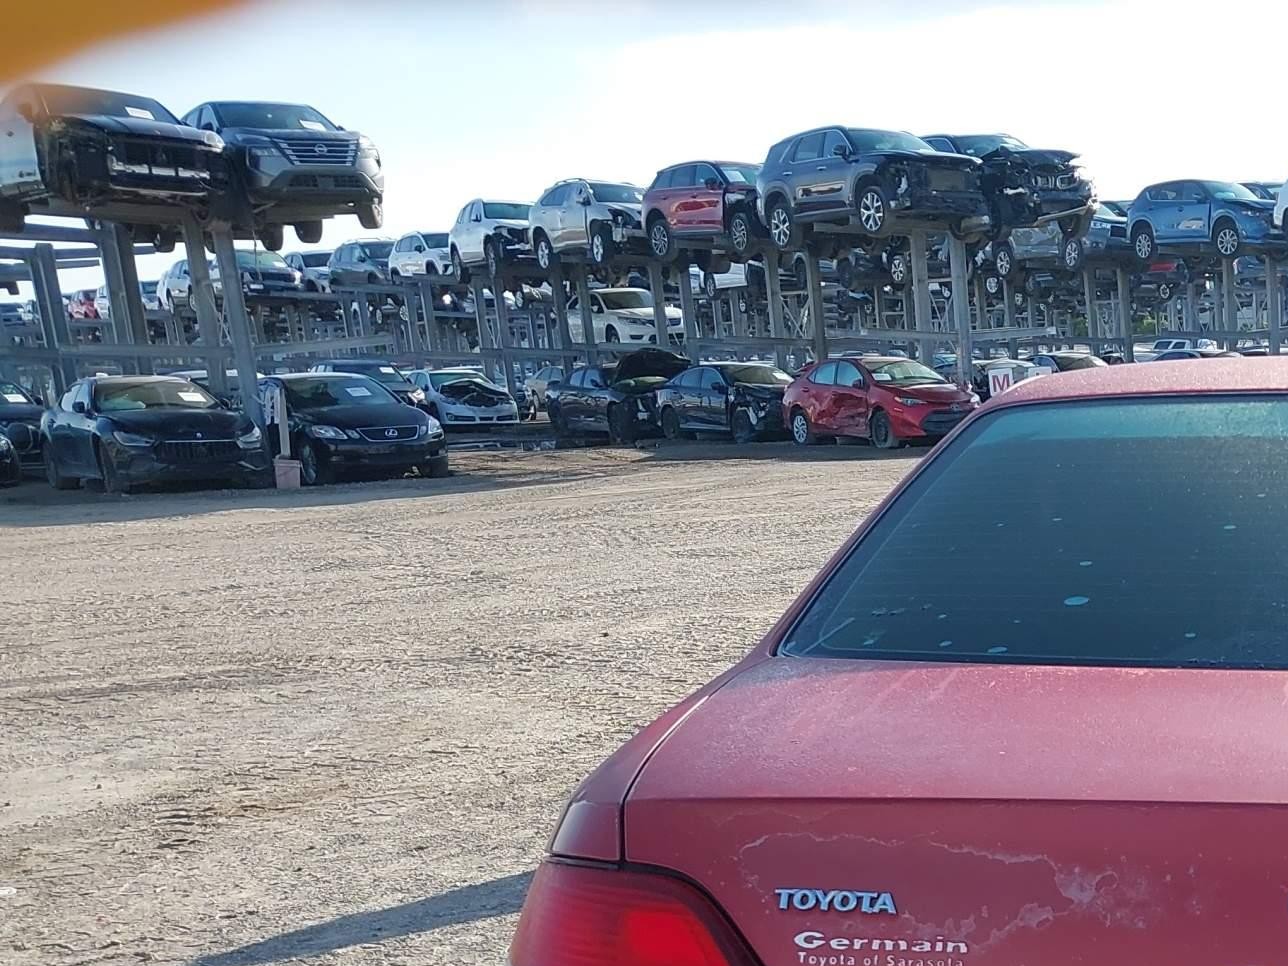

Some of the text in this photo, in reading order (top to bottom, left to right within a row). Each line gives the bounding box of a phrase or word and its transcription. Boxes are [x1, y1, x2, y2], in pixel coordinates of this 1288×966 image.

[992, 373, 1010, 393] M
[774, 887, 898, 915] TOYOTA
[793, 931, 969, 953] Germain
[863, 954, 879, 966] of
